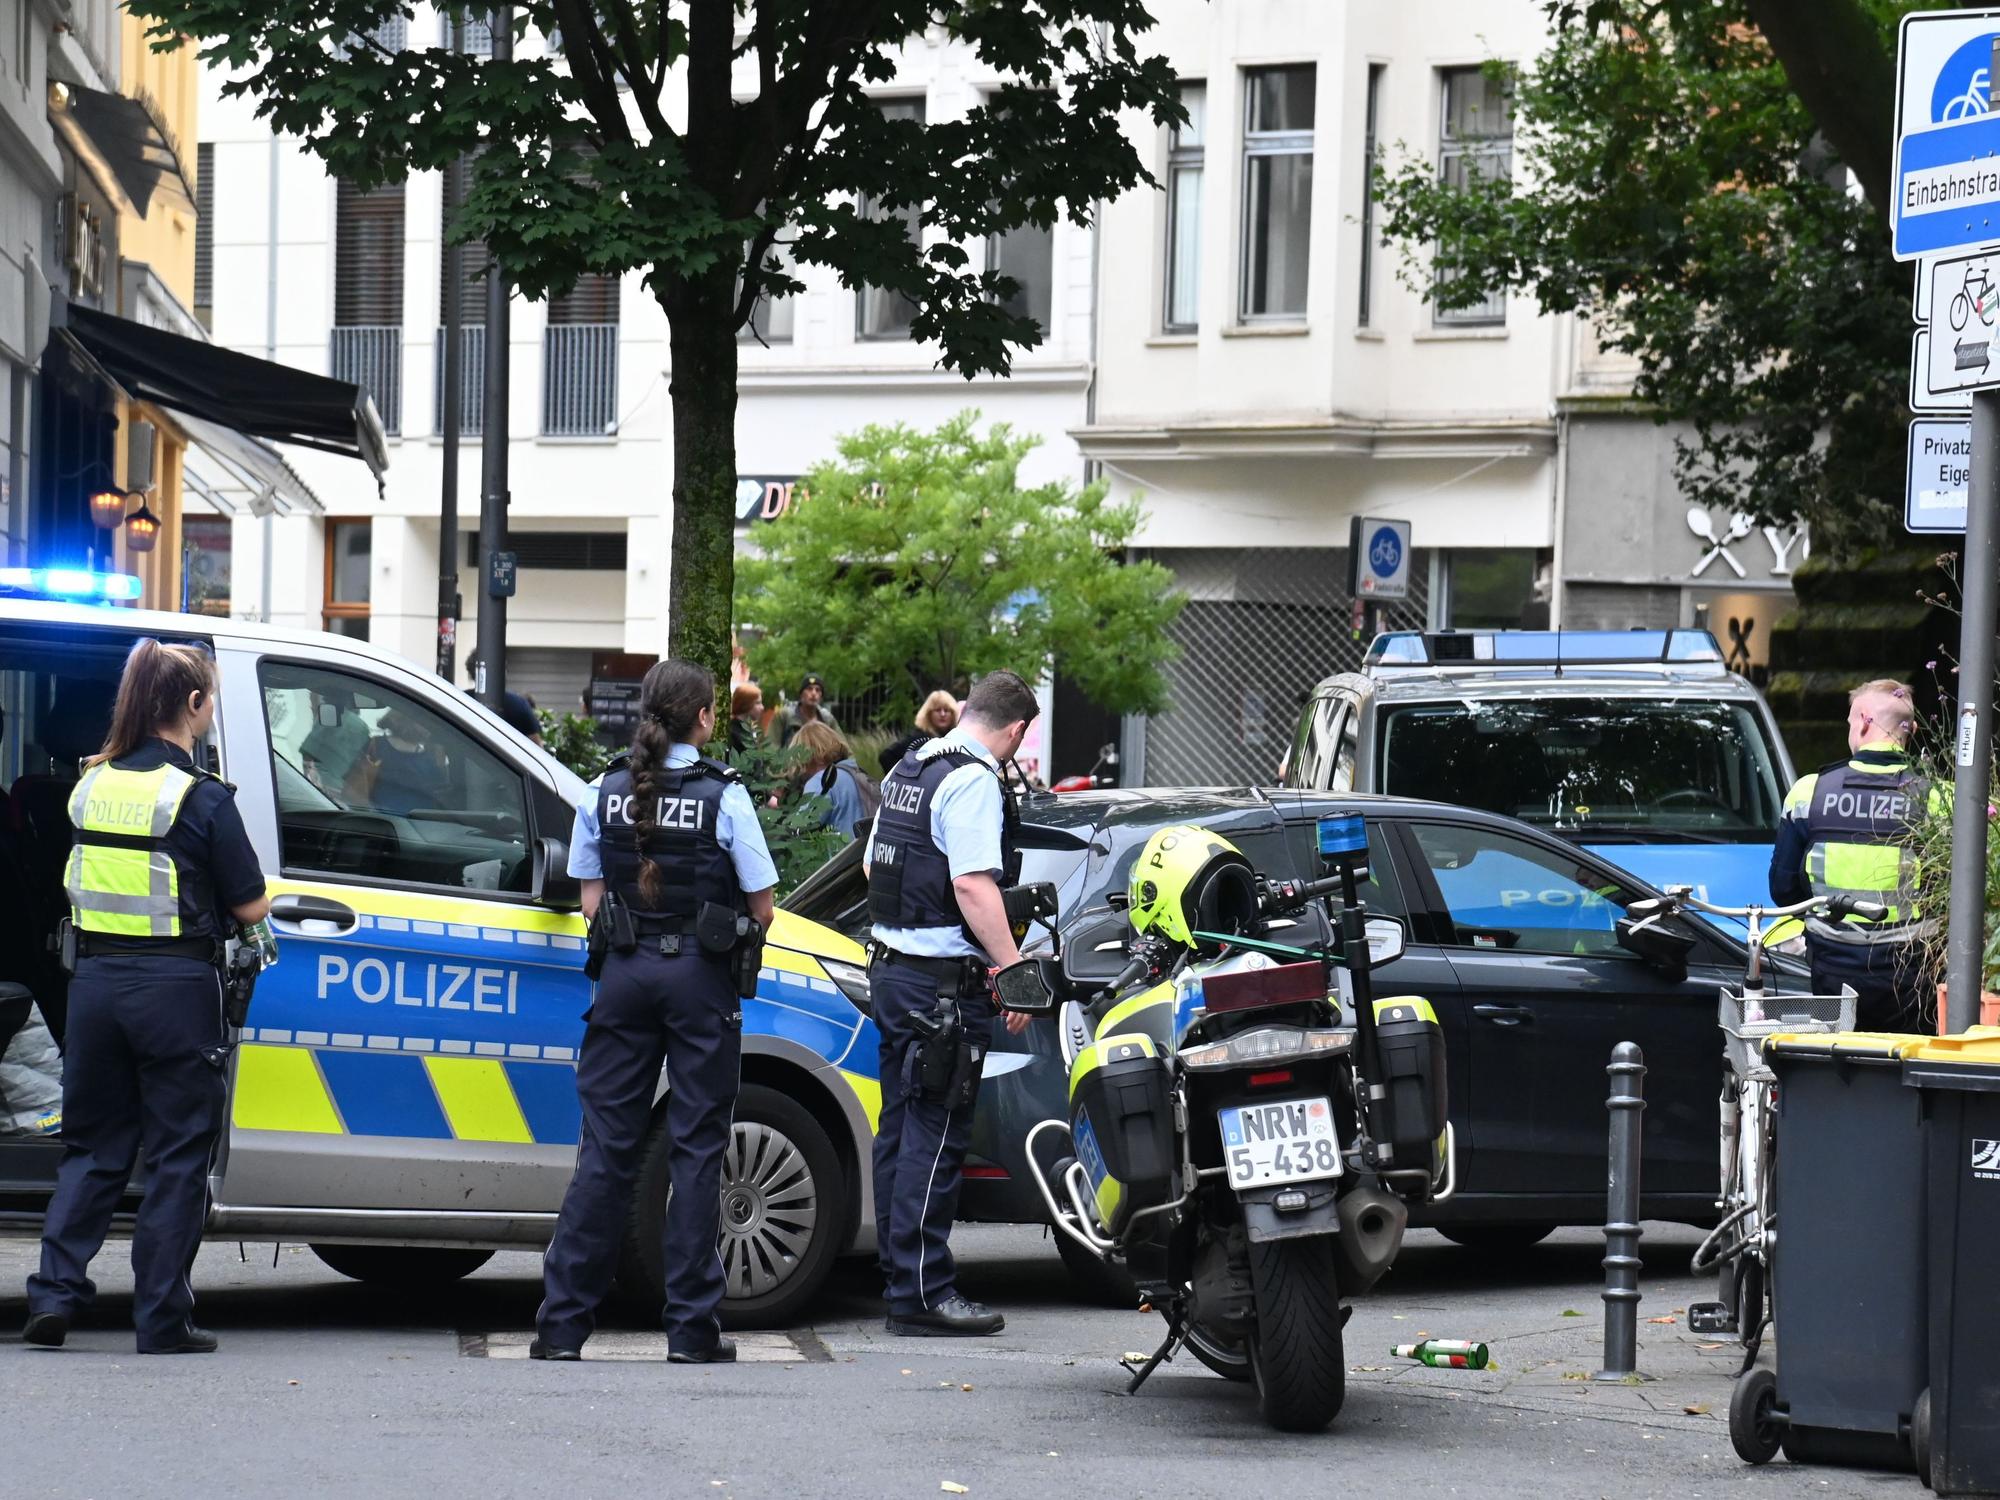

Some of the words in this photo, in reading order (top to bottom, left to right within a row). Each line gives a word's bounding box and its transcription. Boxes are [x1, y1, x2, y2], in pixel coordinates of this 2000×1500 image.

[1907, 170, 2000, 208] Einbahnstra
[1925, 437, 1971, 455] Privatz
[1940, 464, 1970, 486] Eige
[84, 800, 152, 826] POLIZEI
[606, 794, 704, 829] POIZEI
[873, 841, 896, 864] NRW
[318, 954, 519, 1015] POLIZEI
[1242, 1104, 1307, 1143] NRW
